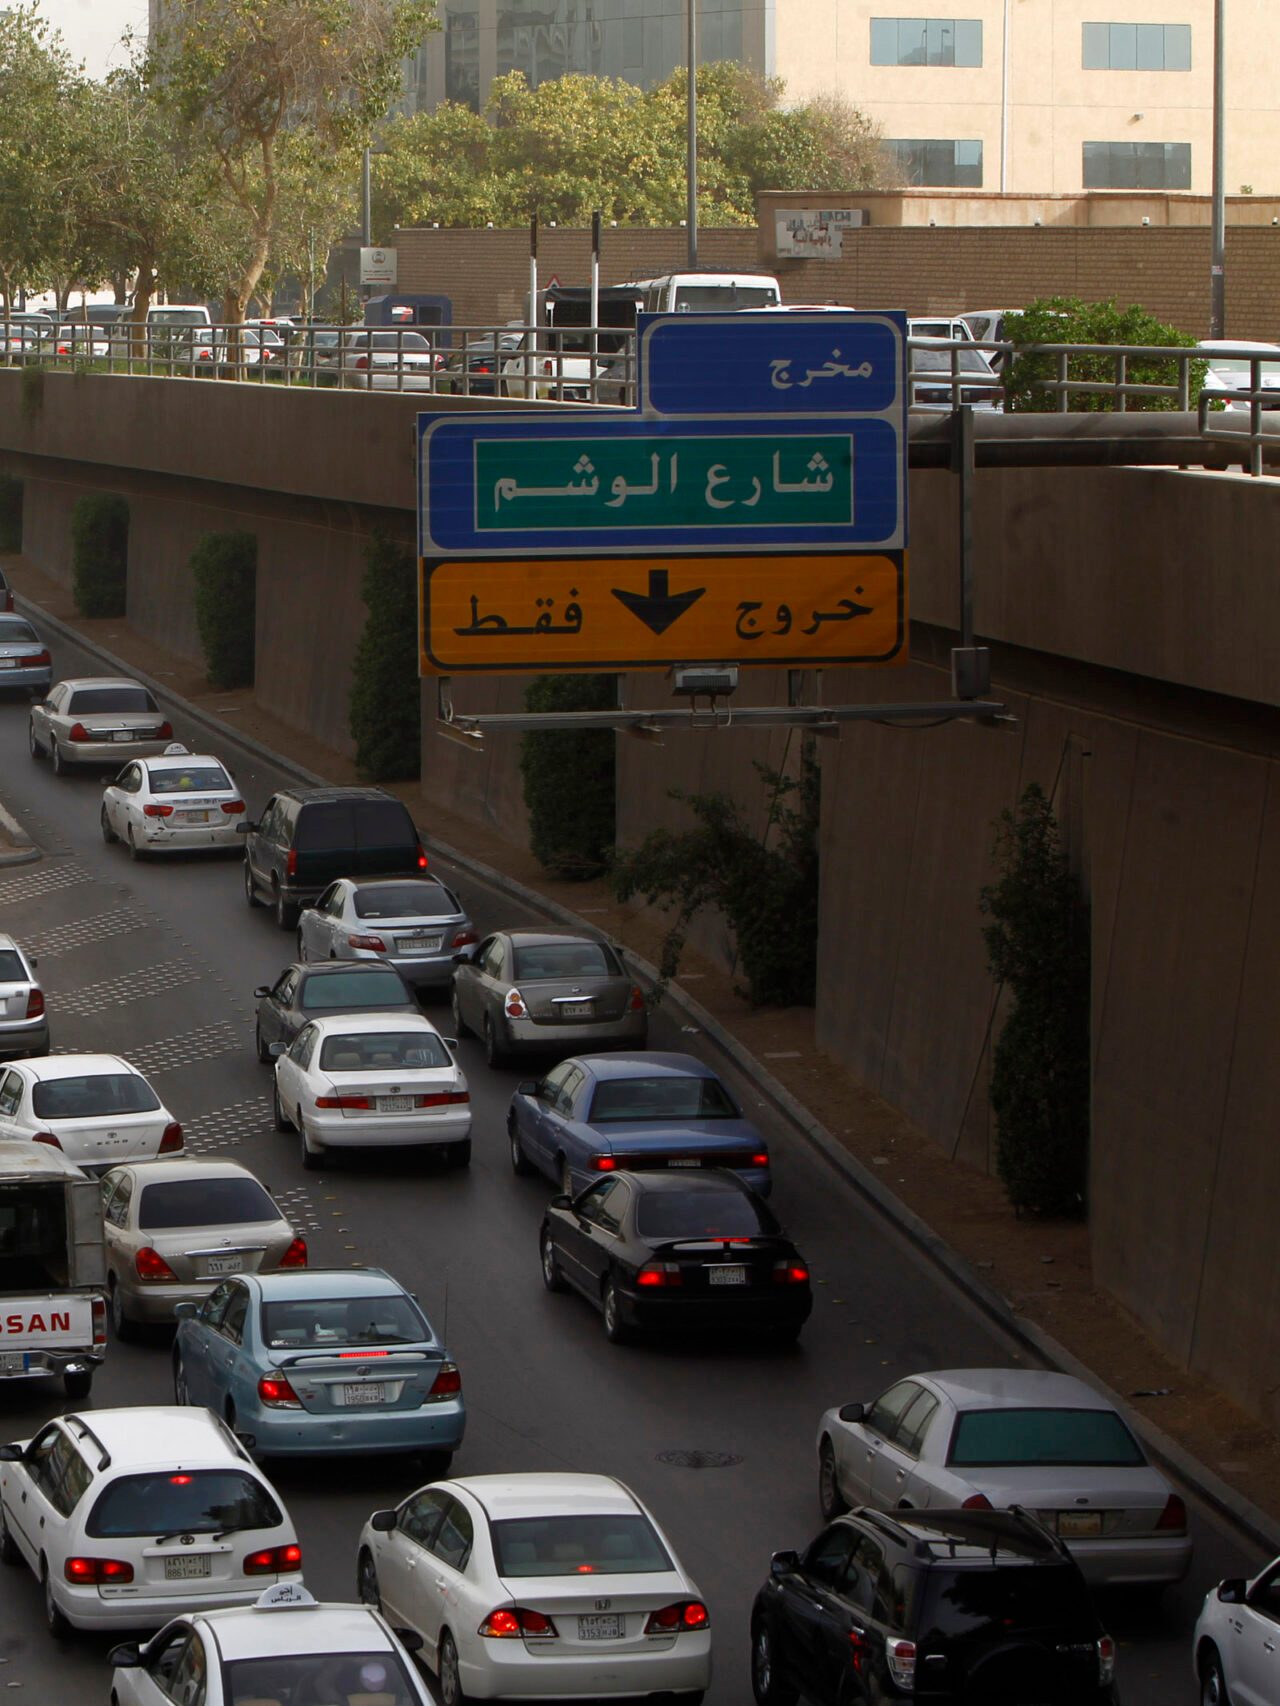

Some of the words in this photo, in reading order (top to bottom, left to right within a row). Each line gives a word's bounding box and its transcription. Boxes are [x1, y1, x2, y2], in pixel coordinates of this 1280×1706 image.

[768, 348, 873, 389] مخرج
[493, 451, 678, 513] الوشم
[704, 451, 833, 509] شارع
[452, 587, 583, 637] فقط
[735, 585, 875, 640] خروج
[579, 1629, 600, 1639] 3153
